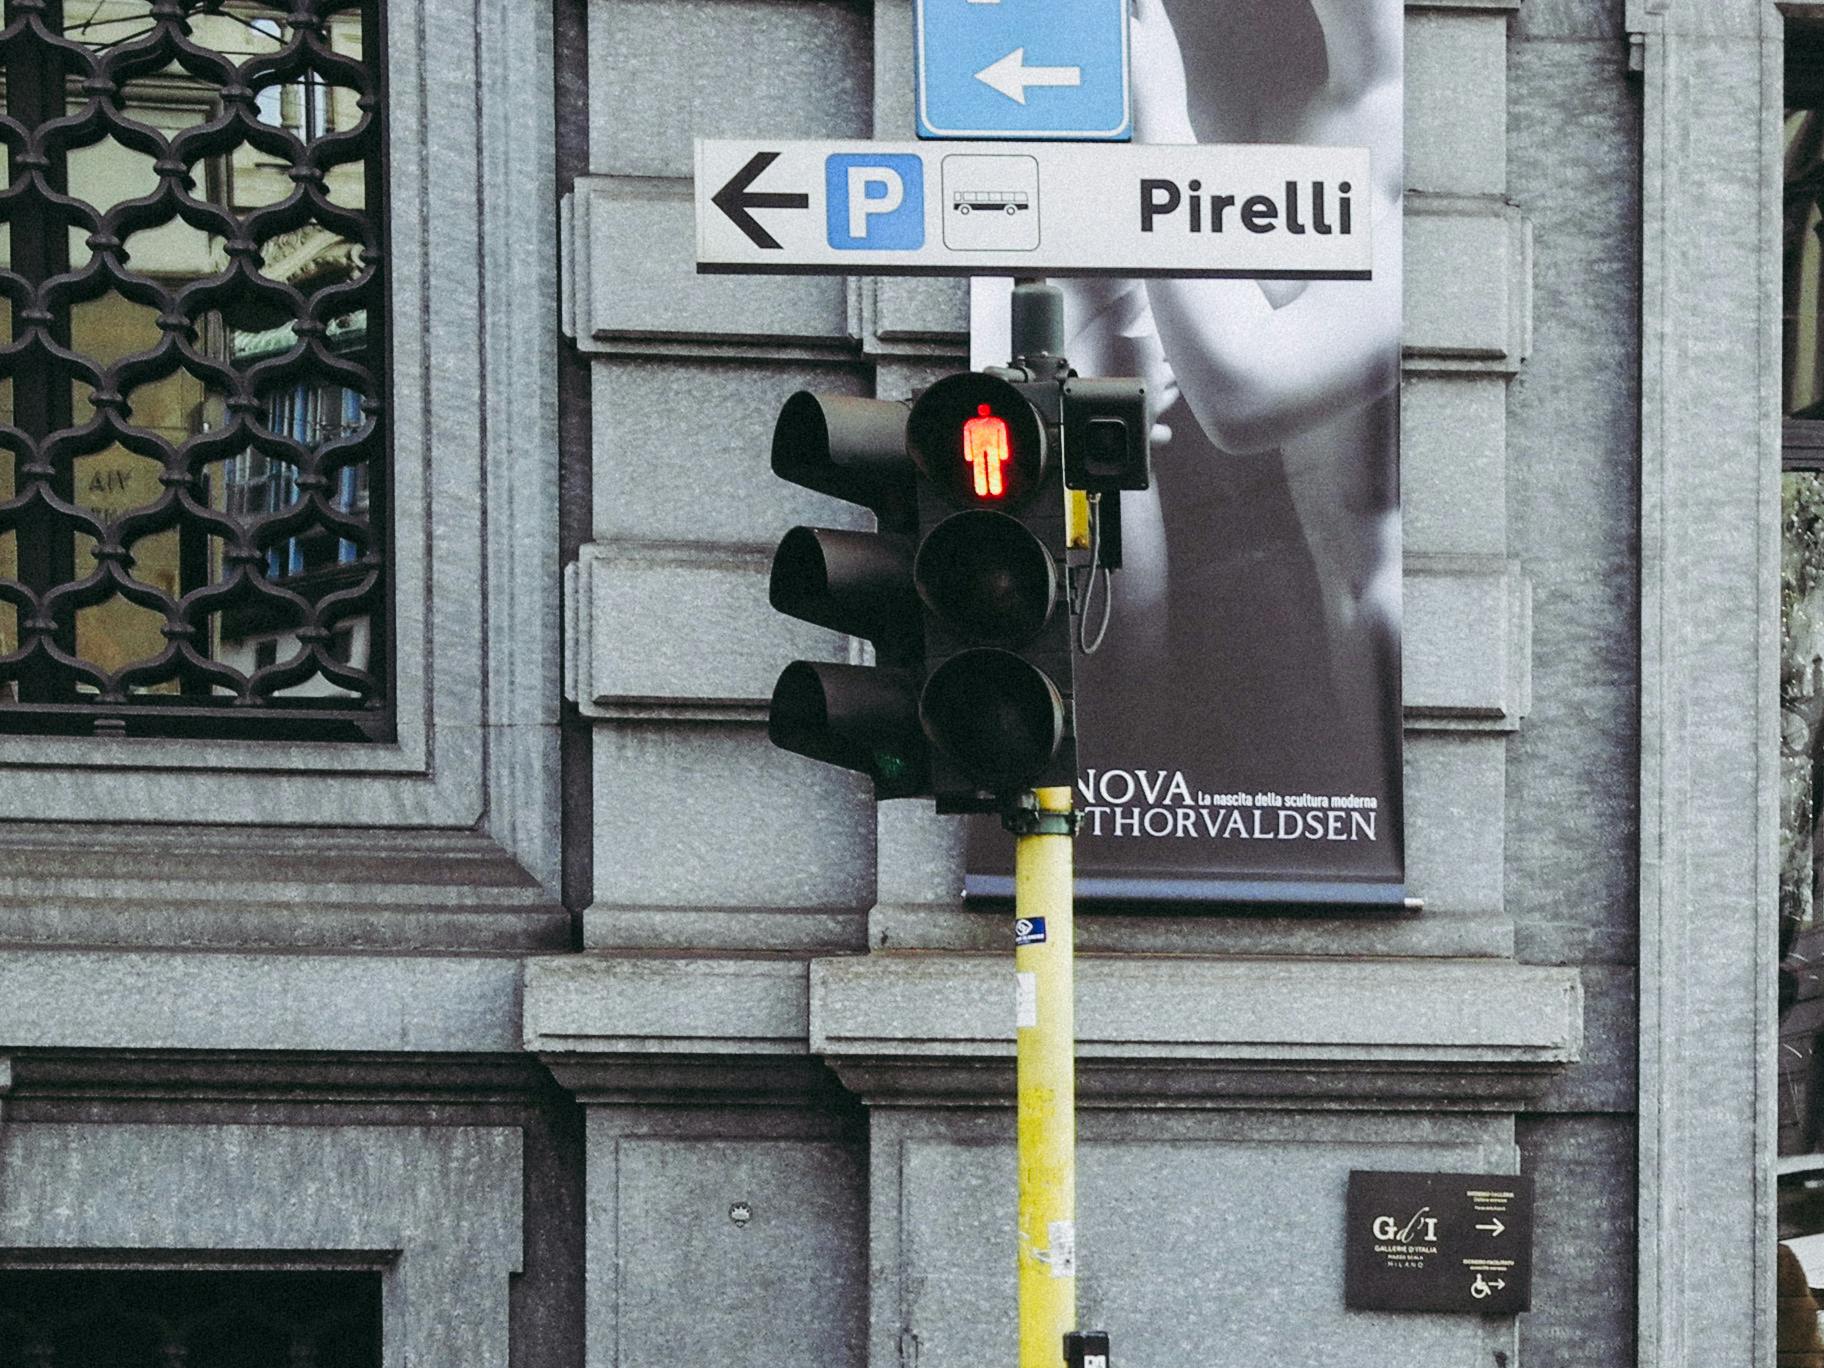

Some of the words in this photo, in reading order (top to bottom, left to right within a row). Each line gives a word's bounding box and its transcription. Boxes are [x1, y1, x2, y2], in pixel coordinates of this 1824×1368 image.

[847, 166, 904, 239] P
[1140, 178, 1352, 235] Pirelli
[1198, 791, 1211, 805] La
[1213, 792, 1252, 807] nascita
[1254, 792, 1282, 807] della
[1284, 793, 1329, 808] scultura
[1330, 794, 1378, 809] moderna
[1084, 806, 1377, 841] THORVALDSEN
